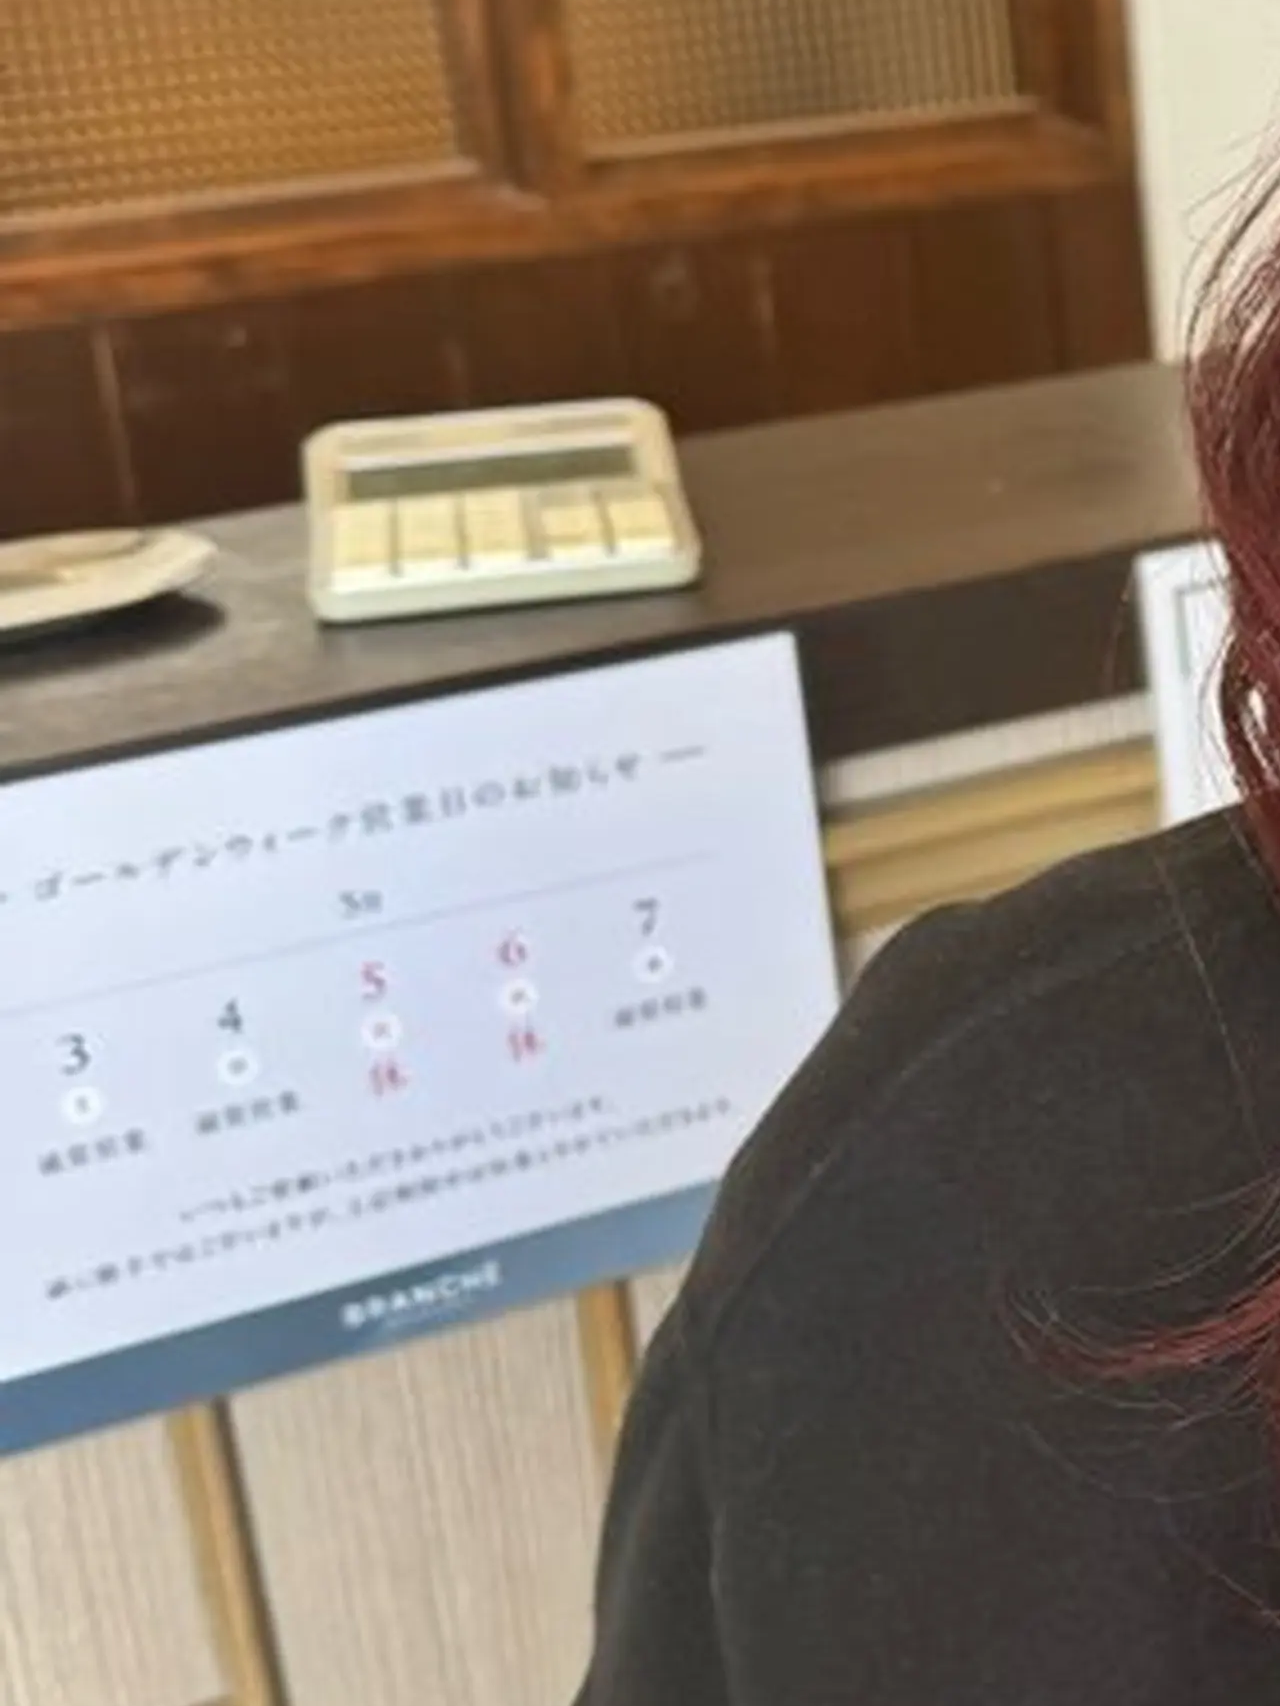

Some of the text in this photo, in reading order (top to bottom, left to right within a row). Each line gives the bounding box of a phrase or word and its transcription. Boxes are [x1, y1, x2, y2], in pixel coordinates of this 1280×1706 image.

[632, 896, 660, 937] 7
[497, 925, 529, 969] 6
[359, 960, 388, 1003] 5
[216, 997, 245, 1035] 4
[56, 1032, 92, 1077] 3
